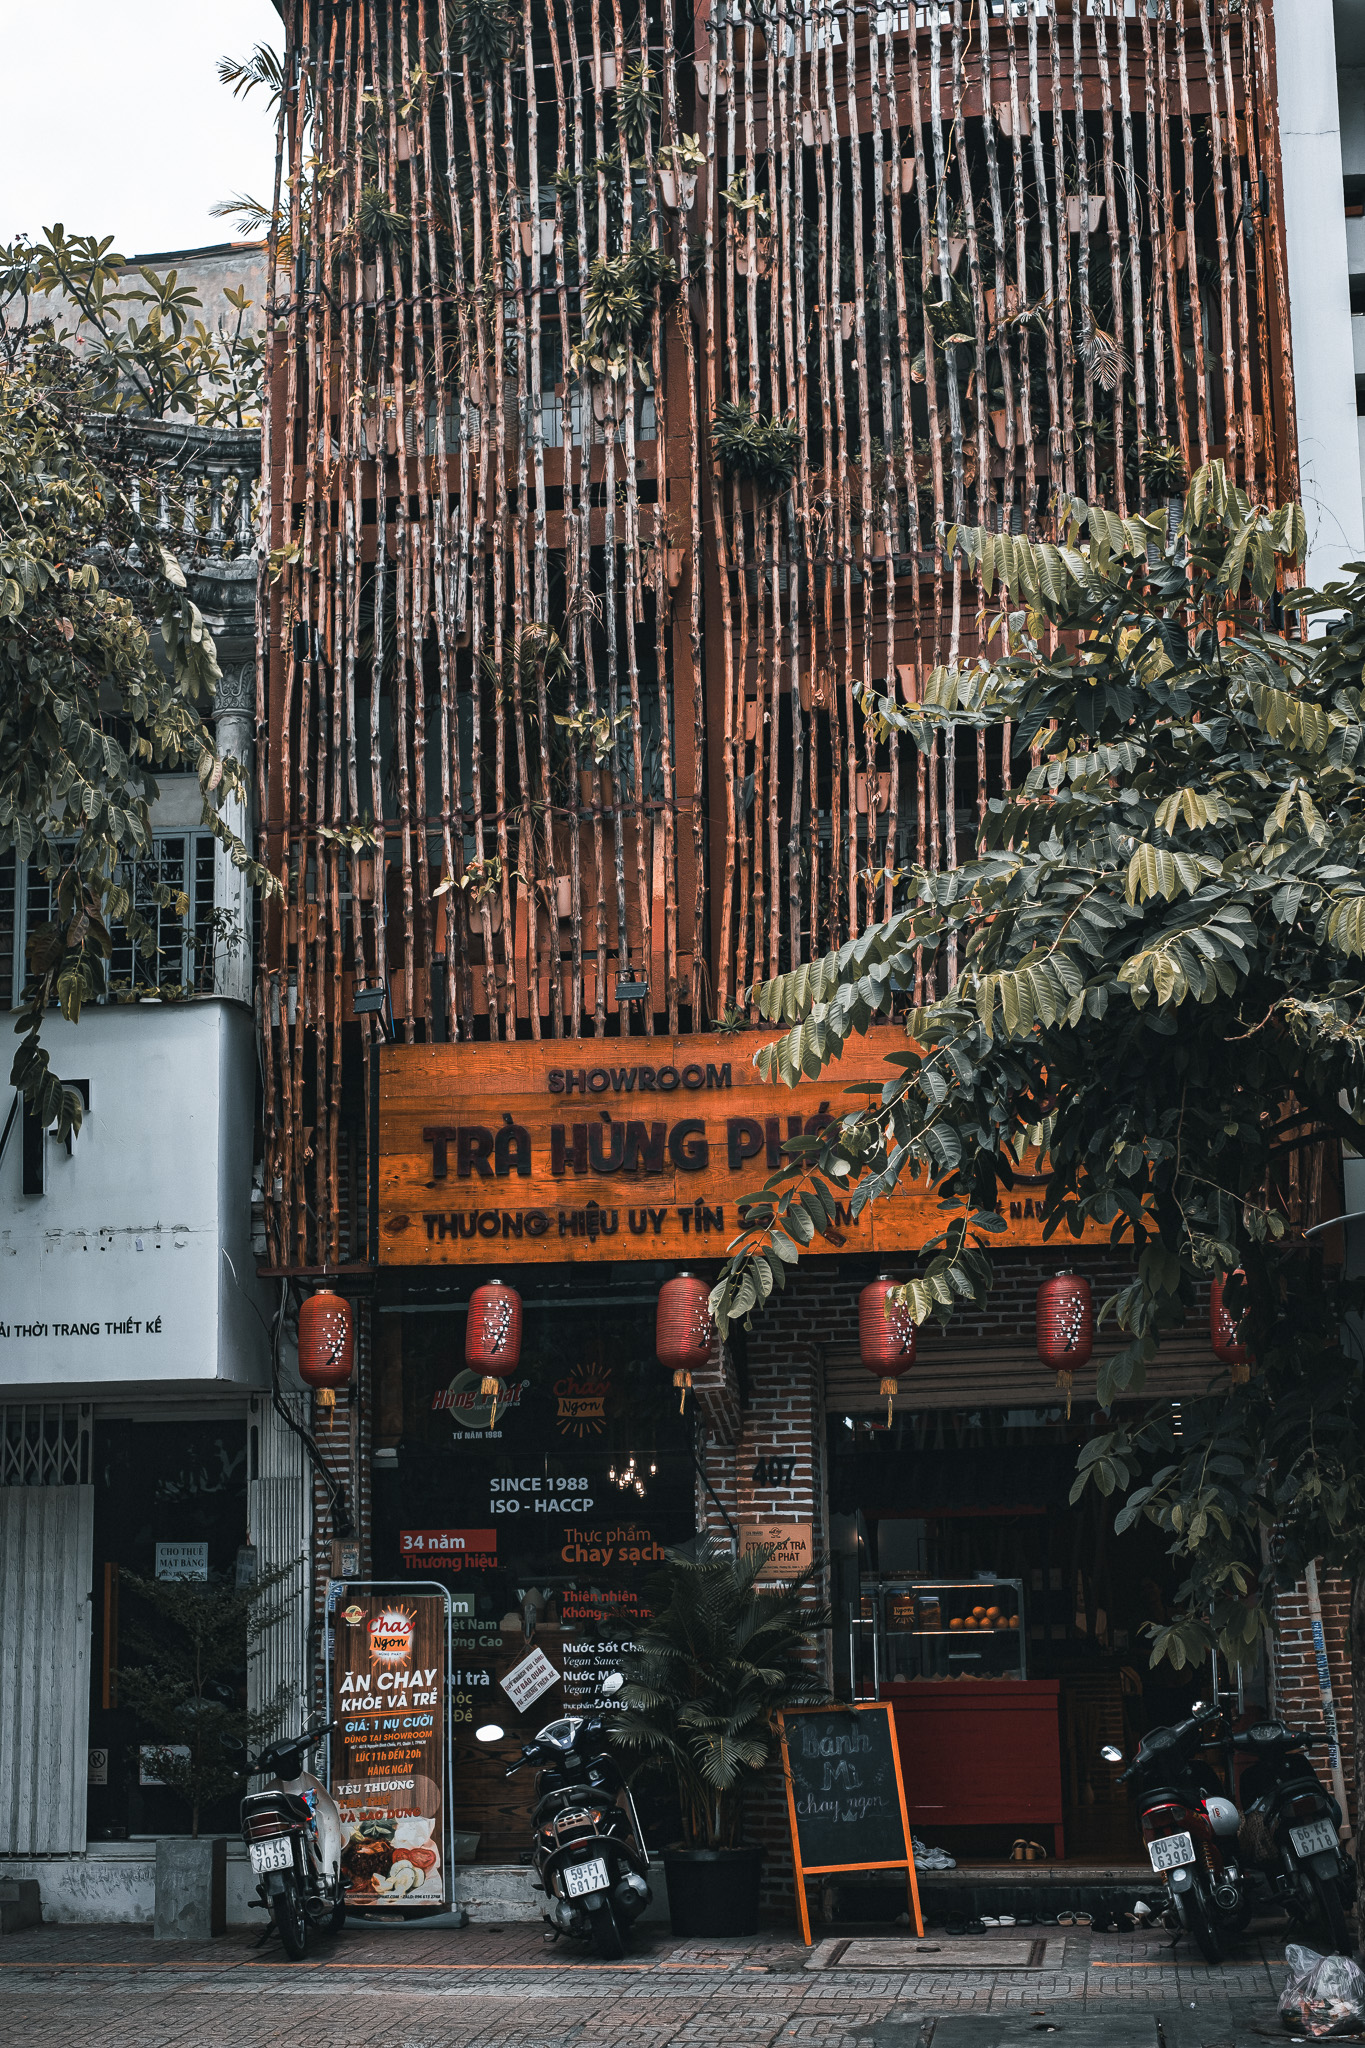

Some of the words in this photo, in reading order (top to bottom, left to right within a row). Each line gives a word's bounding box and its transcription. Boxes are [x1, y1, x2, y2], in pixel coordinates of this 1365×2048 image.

[548, 1063, 732, 1093] SHOWROOM
[423, 1113, 531, 1176] TRÀ
[551, 1110, 709, 1173] HÙNG
[423, 1208, 549, 1239] THƯƠNG
[558, 1200, 618, 1242] HIỆU
[629, 1208, 668, 1234] UY
[678, 1197, 724, 1233] TÍN
[14, 1321, 48, 1337] THỜI
[52, 1322, 100, 1336] TRANG
[105, 1316, 142, 1335] THIẾT
[145, 1315, 162, 1333] KẾ
[553, 1377, 612, 1398] Chay
[432, 1388, 478, 1410] Hùng
[562, 1400, 601, 1416] Ngon
[485, 1430, 503, 1439] 1988
[752, 1456, 796, 1487] 407
[489, 1477, 542, 1492] SINCE
[546, 1477, 589, 1491] 1988
[490, 1499, 520, 1513] ISO
[535, 1498, 594, 1512] HACCP
[403, 1535, 425, 1550] 34
[428, 1534, 466, 1549] năm
[563, 1528, 602, 1546] Thực
[605, 1524, 651, 1545] phẩm
[160, 1547, 179, 1556] CHO
[181, 1545, 204, 1556] THUÊ
[790, 1539, 807, 1550] TRÀ
[561, 1544, 614, 1567] Chay
[618, 1541, 665, 1566] sạch
[778, 1551, 800, 1561] PHÁT
[402, 1554, 462, 1572] Thương
[465, 1553, 498, 1572] hiệu
[562, 1590, 598, 1602] Thiên
[601, 1590, 637, 1602] nhiên
[562, 1606, 602, 1621] Không
[367, 1616, 416, 1634] Chay
[467, 1618, 498, 1630] Nam
[373, 1636, 407, 1651] Ngon
[479, 1635, 504, 1647] Cao
[562, 1642, 595, 1653] Nước
[597, 1641, 619, 1653] Sốt
[563, 1656, 591, 1669] Vegan
[339, 1671, 371, 1693] ĂN
[377, 1669, 437, 1691] CHAY
[465, 1669, 490, 1686] trà
[562, 1671, 595, 1681] Nước
[563, 1684, 591, 1696] Vegan
[341, 1692, 382, 1712] KHỎE
[387, 1690, 408, 1708] VÀ
[412, 1687, 438, 1706] TRẺ
[345, 1718, 370, 1733] GIÁ:
[374, 1720, 379, 1730] 1
[383, 1718, 400, 1731] NỤ
[402, 1714, 434, 1727] CƯỜI
[344, 1734, 367, 1744] DÙNG
[370, 1734, 382, 1744] TẠI
[383, 1730, 433, 1741] SHOWROOM
[802, 1723, 872, 1758] Bánh
[355, 1750, 370, 1762] LÚC
[371, 1751, 387, 1761] 11h
[387, 1748, 405, 1760] ĐẾN
[405, 1748, 422, 1759] 20h
[367, 1764, 391, 1776] HÀNG
[391, 1762, 414, 1774] NGÀY
[820, 1760, 863, 1791] Mì
[337, 1783, 362, 1795] YÊU
[338, 1798, 363, 1809] THA
[366, 1793, 391, 1807] THỨ
[797, 1793, 842, 1823] chay
[847, 1796, 890, 1818] ngon
[339, 1810, 356, 1823] VÀ
[359, 1810, 384, 1821] BAO
[387, 1807, 422, 1819] DUNG
[1301, 1834, 1333, 1854] 6718
[1157, 1849, 1189, 1868] 6396
[570, 1862, 600, 1881] 59-F1
[569, 1873, 606, 1895] 681.71
